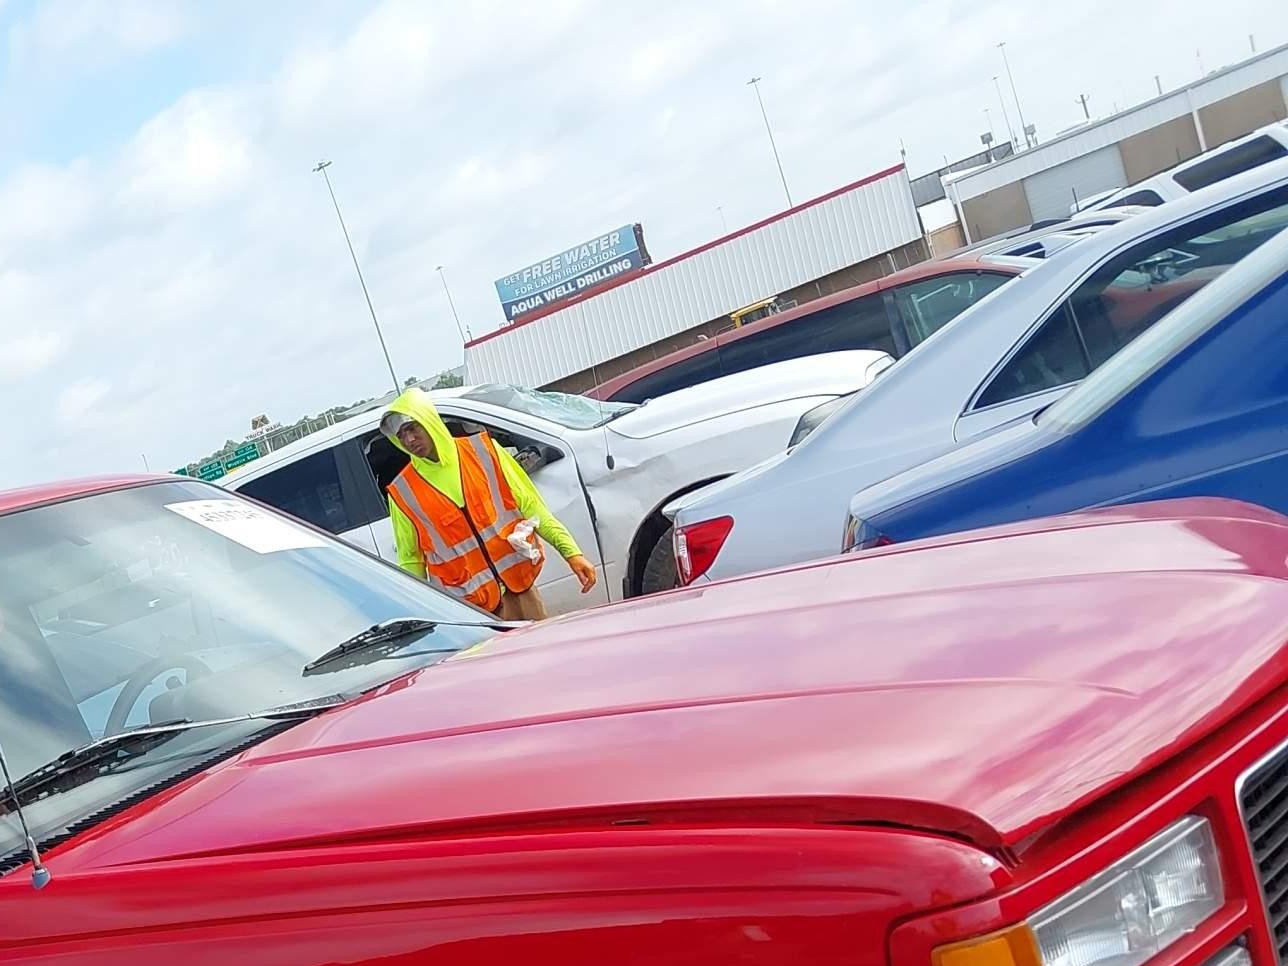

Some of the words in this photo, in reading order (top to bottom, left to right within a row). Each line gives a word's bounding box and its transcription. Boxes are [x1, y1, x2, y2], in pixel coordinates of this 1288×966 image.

[503, 273, 521, 286] GET
[523, 257, 561, 282] FREE
[564, 233, 620, 265] WATER
[514, 284, 534, 297] FOR
[535, 272, 562, 290] LAWN
[563, 249, 616, 276] IRRIGATION
[511, 297, 544, 315] AQUA
[544, 284, 576, 301] WELL
[576, 259, 631, 288] DRILLING
